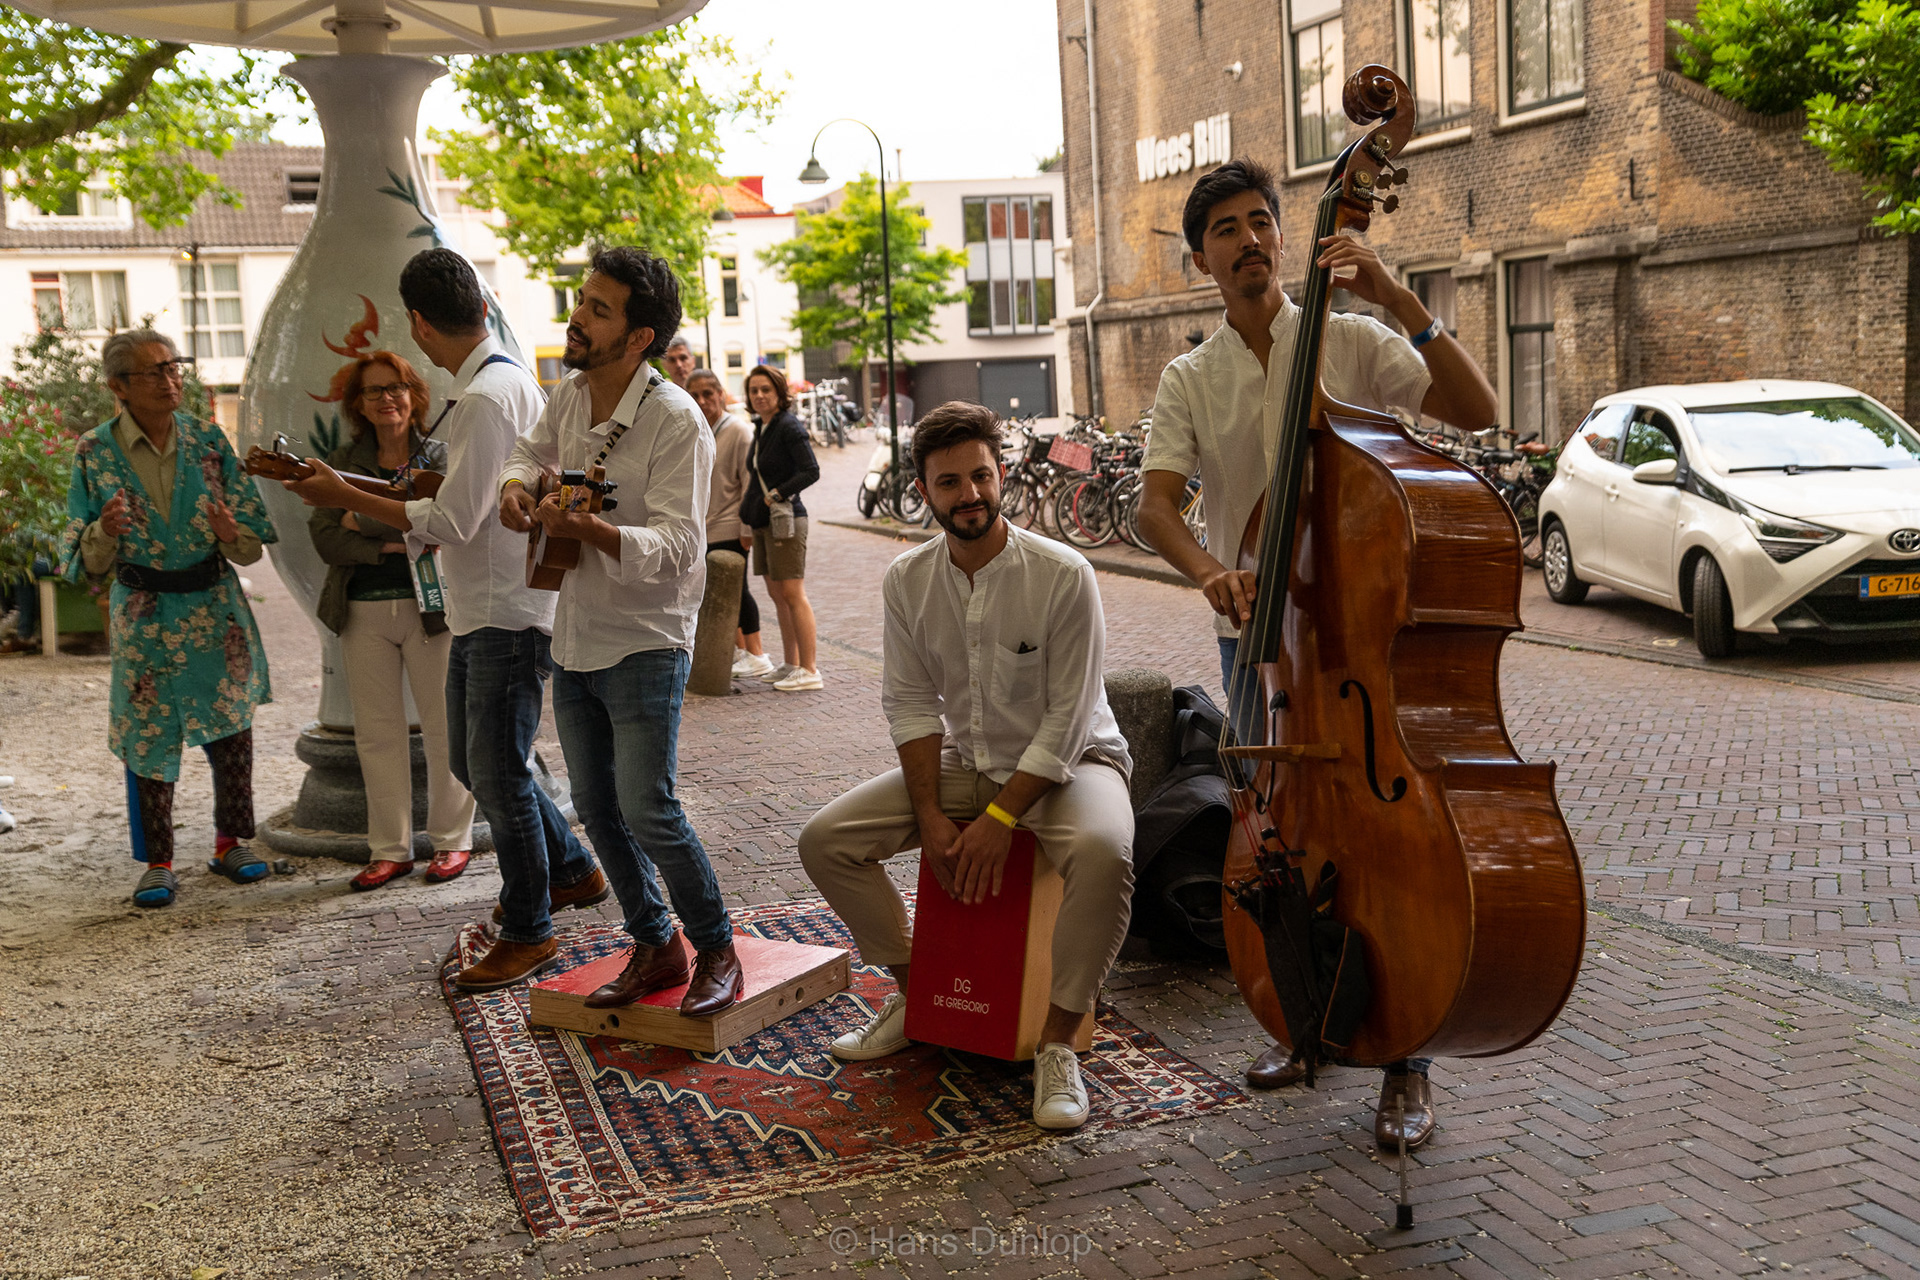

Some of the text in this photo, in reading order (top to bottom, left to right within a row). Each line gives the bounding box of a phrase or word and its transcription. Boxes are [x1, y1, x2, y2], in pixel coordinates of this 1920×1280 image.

[1136, 111, 1231, 183] Wees Blij
[1878, 576, 1920, 592] G-716
[954, 977, 971, 994] DG
[934, 994, 990, 1015] DE GREGORIO
